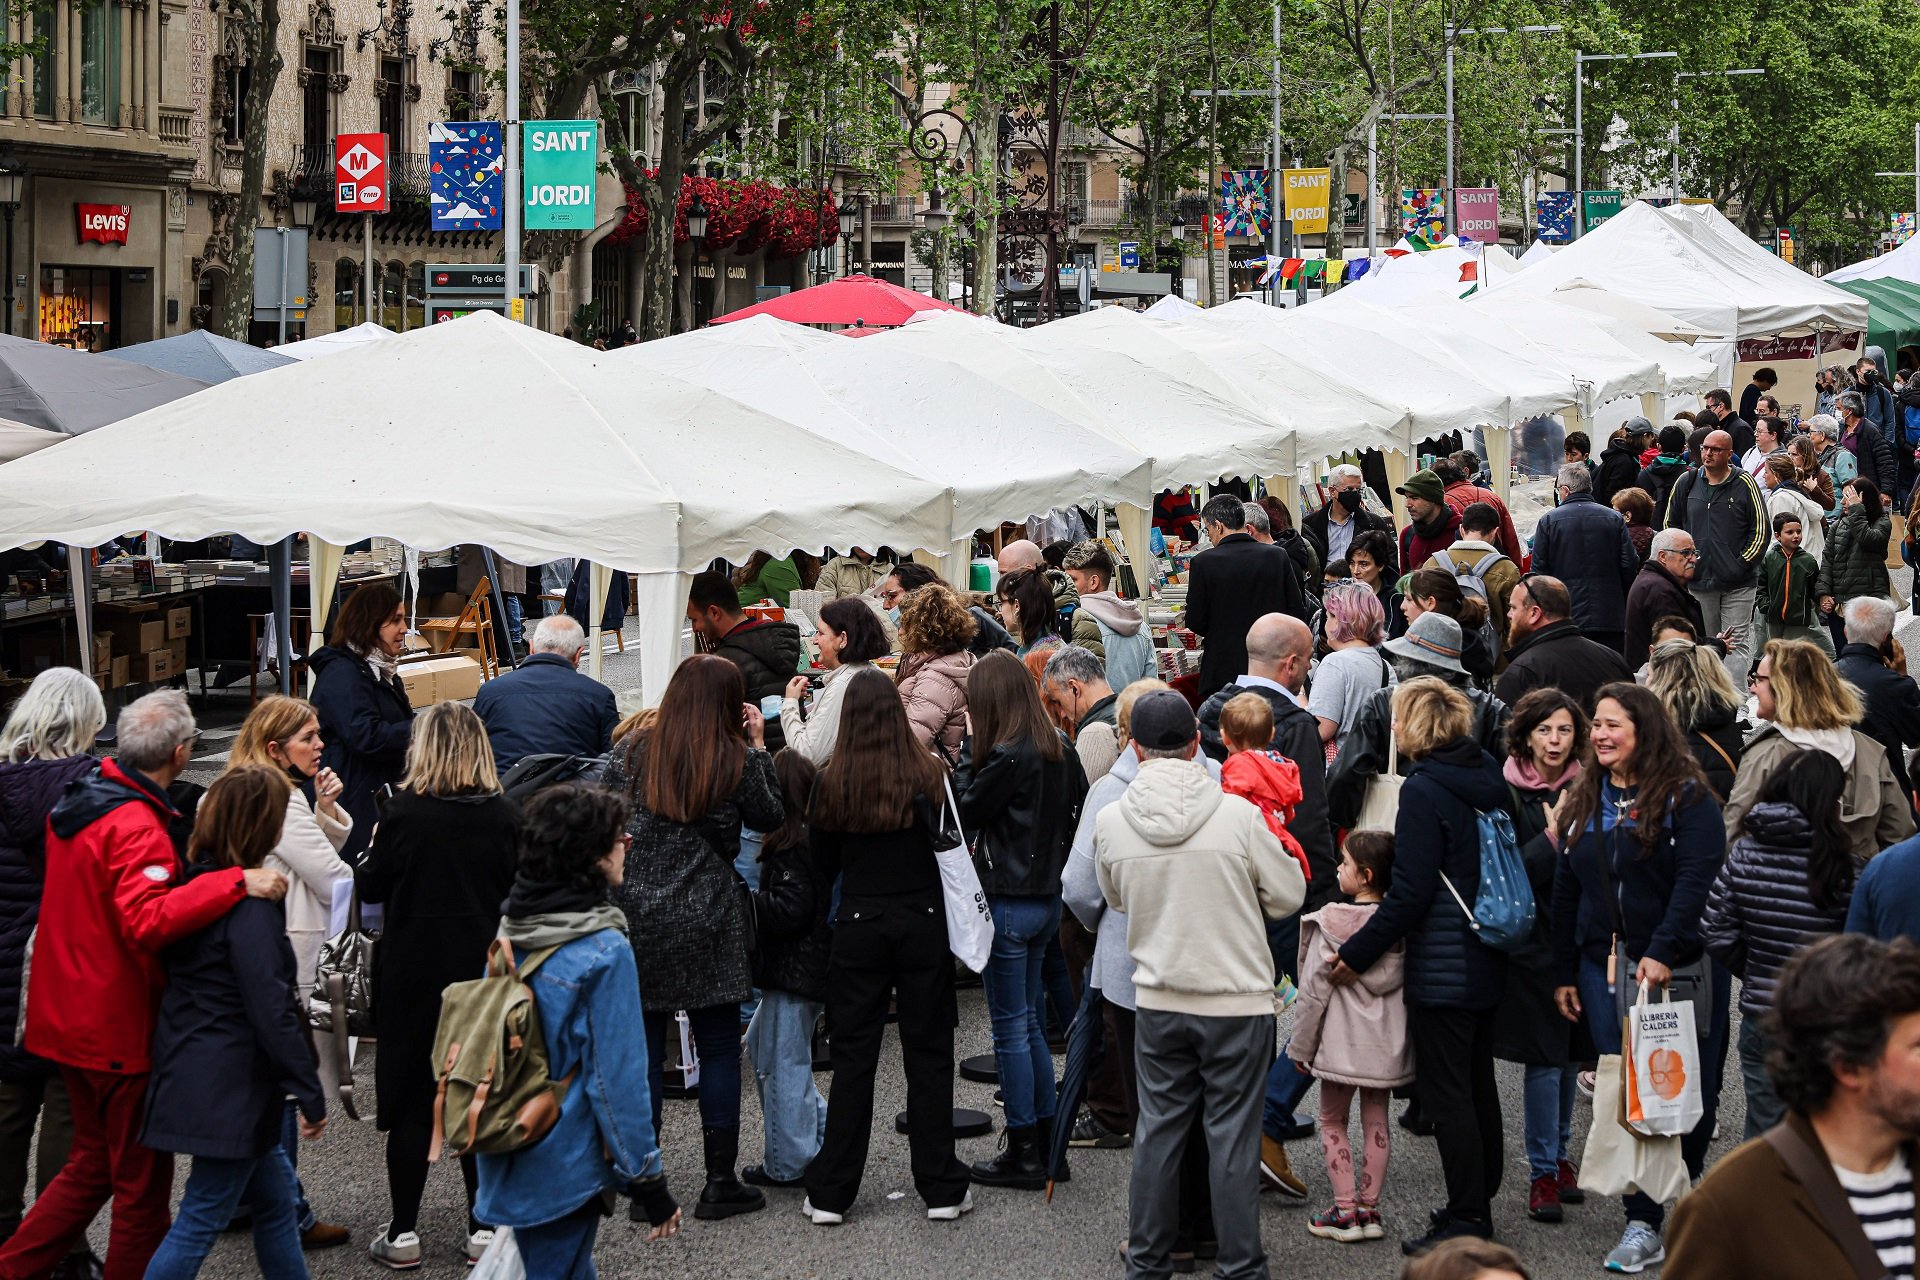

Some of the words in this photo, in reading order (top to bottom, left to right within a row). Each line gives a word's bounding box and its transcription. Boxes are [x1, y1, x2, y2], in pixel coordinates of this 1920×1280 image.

[532, 131, 591, 152] SANT
[349, 153, 368, 170] M
[1289, 175, 1327, 188] SANT
[527, 185, 590, 206] JORDI
[1460, 193, 1495, 204] SANT
[1588, 195, 1619, 204] SANT
[1288, 207, 1325, 221] JORDI
[1460, 219, 1496, 232] JORDI
[471, 274, 482, 284] Pg
[483, 275, 494, 283] de
[1640, 1011, 1678, 1022] LLIBRERIA
[1642, 1020, 1678, 1031] CALDERS
